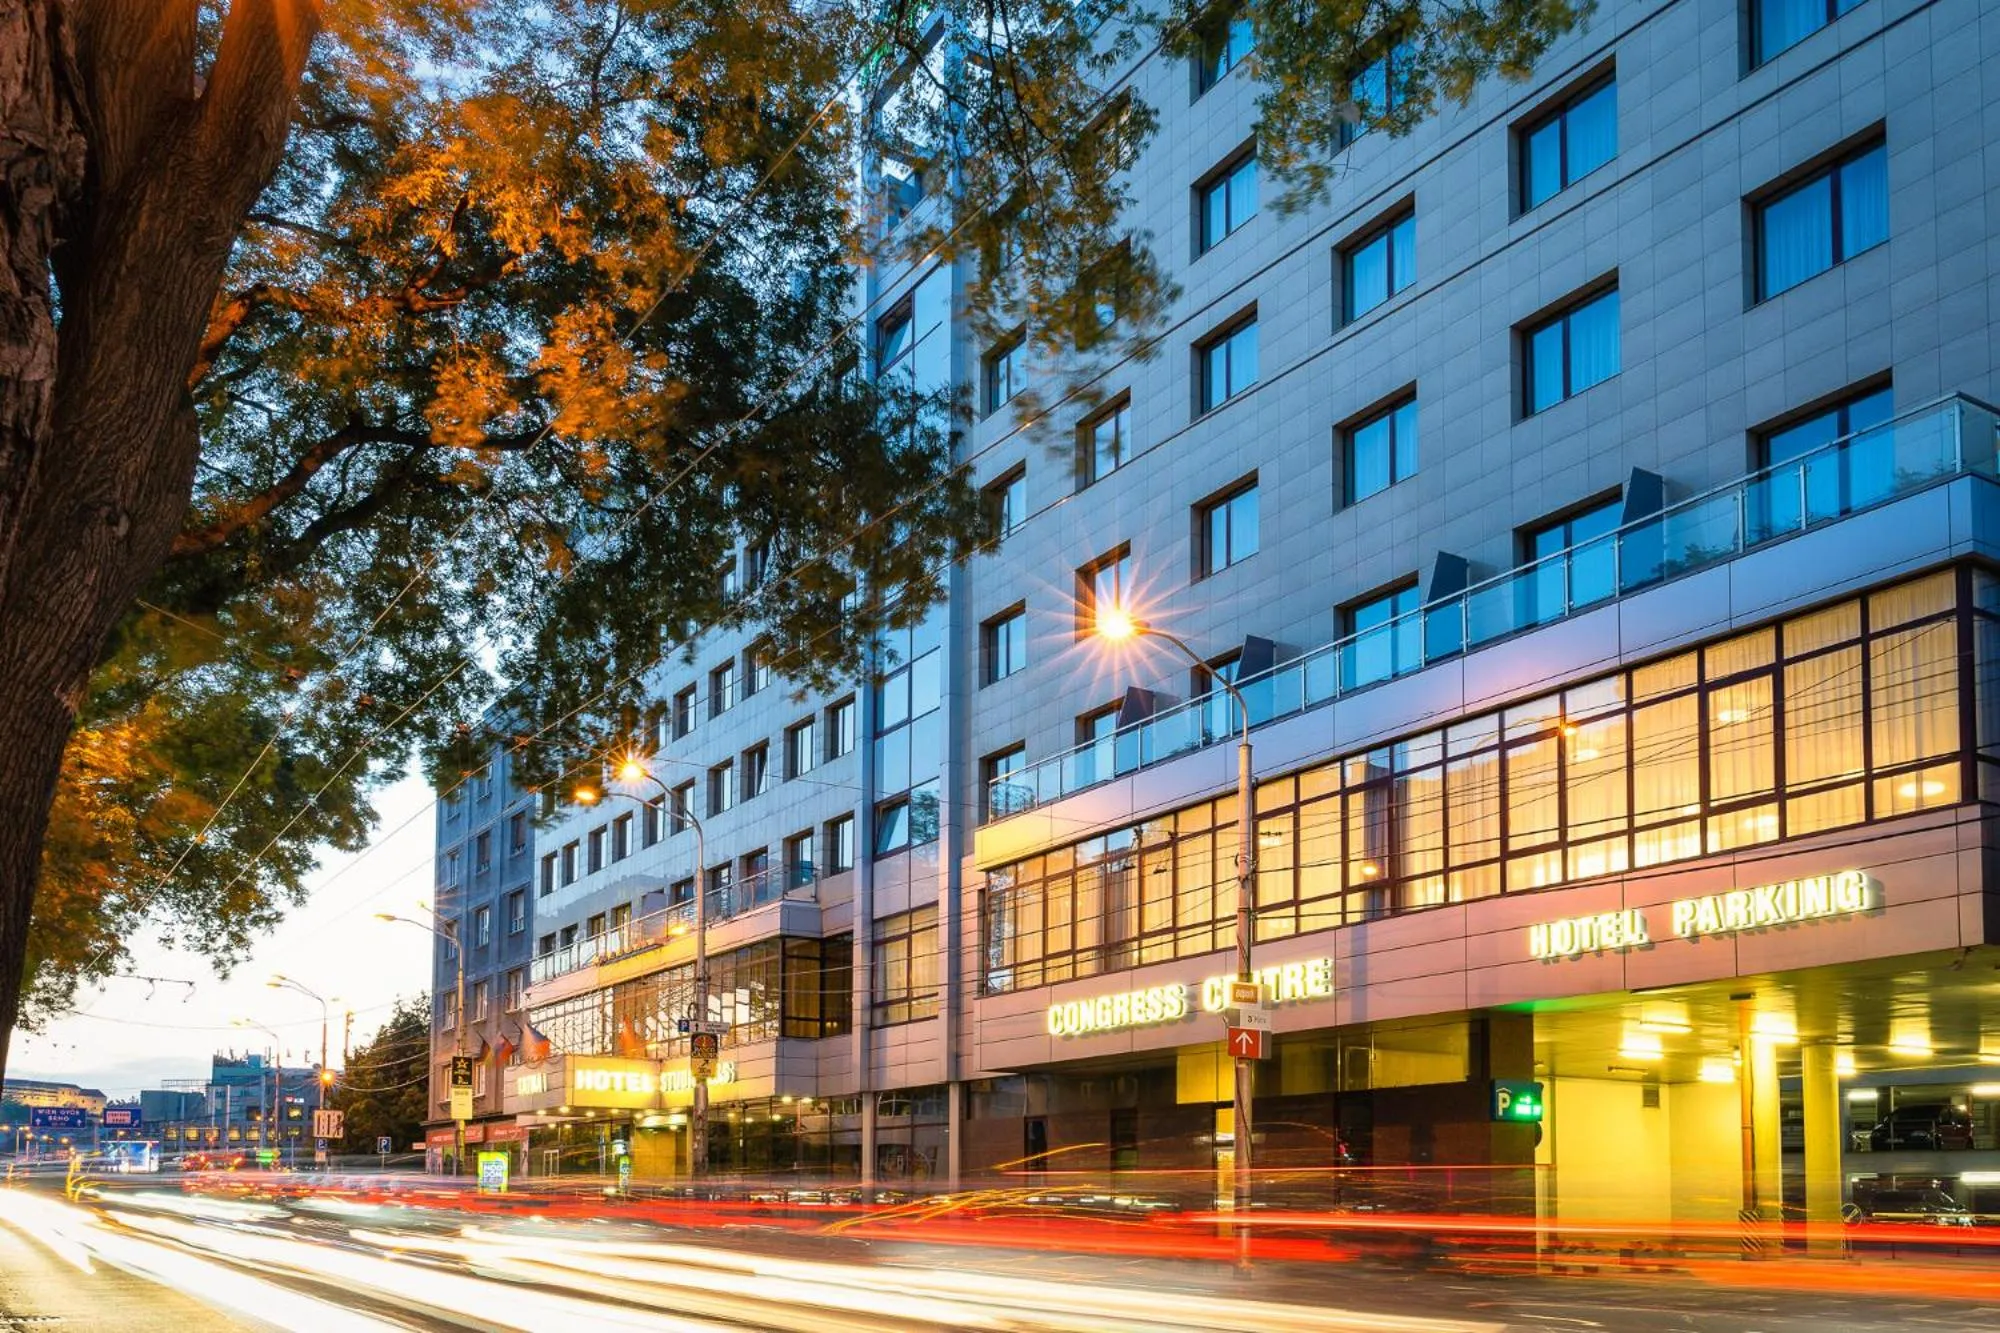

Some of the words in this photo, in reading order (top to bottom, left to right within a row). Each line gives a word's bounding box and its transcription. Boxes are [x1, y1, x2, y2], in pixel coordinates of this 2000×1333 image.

[1529, 908, 1649, 959] HOTEL
[1672, 870, 1872, 936] PARKING
[1048, 984, 1187, 1034] CONGRESS
[1202, 957, 1334, 1012] CETRE
[575, 1069, 656, 1093] HOTEL
